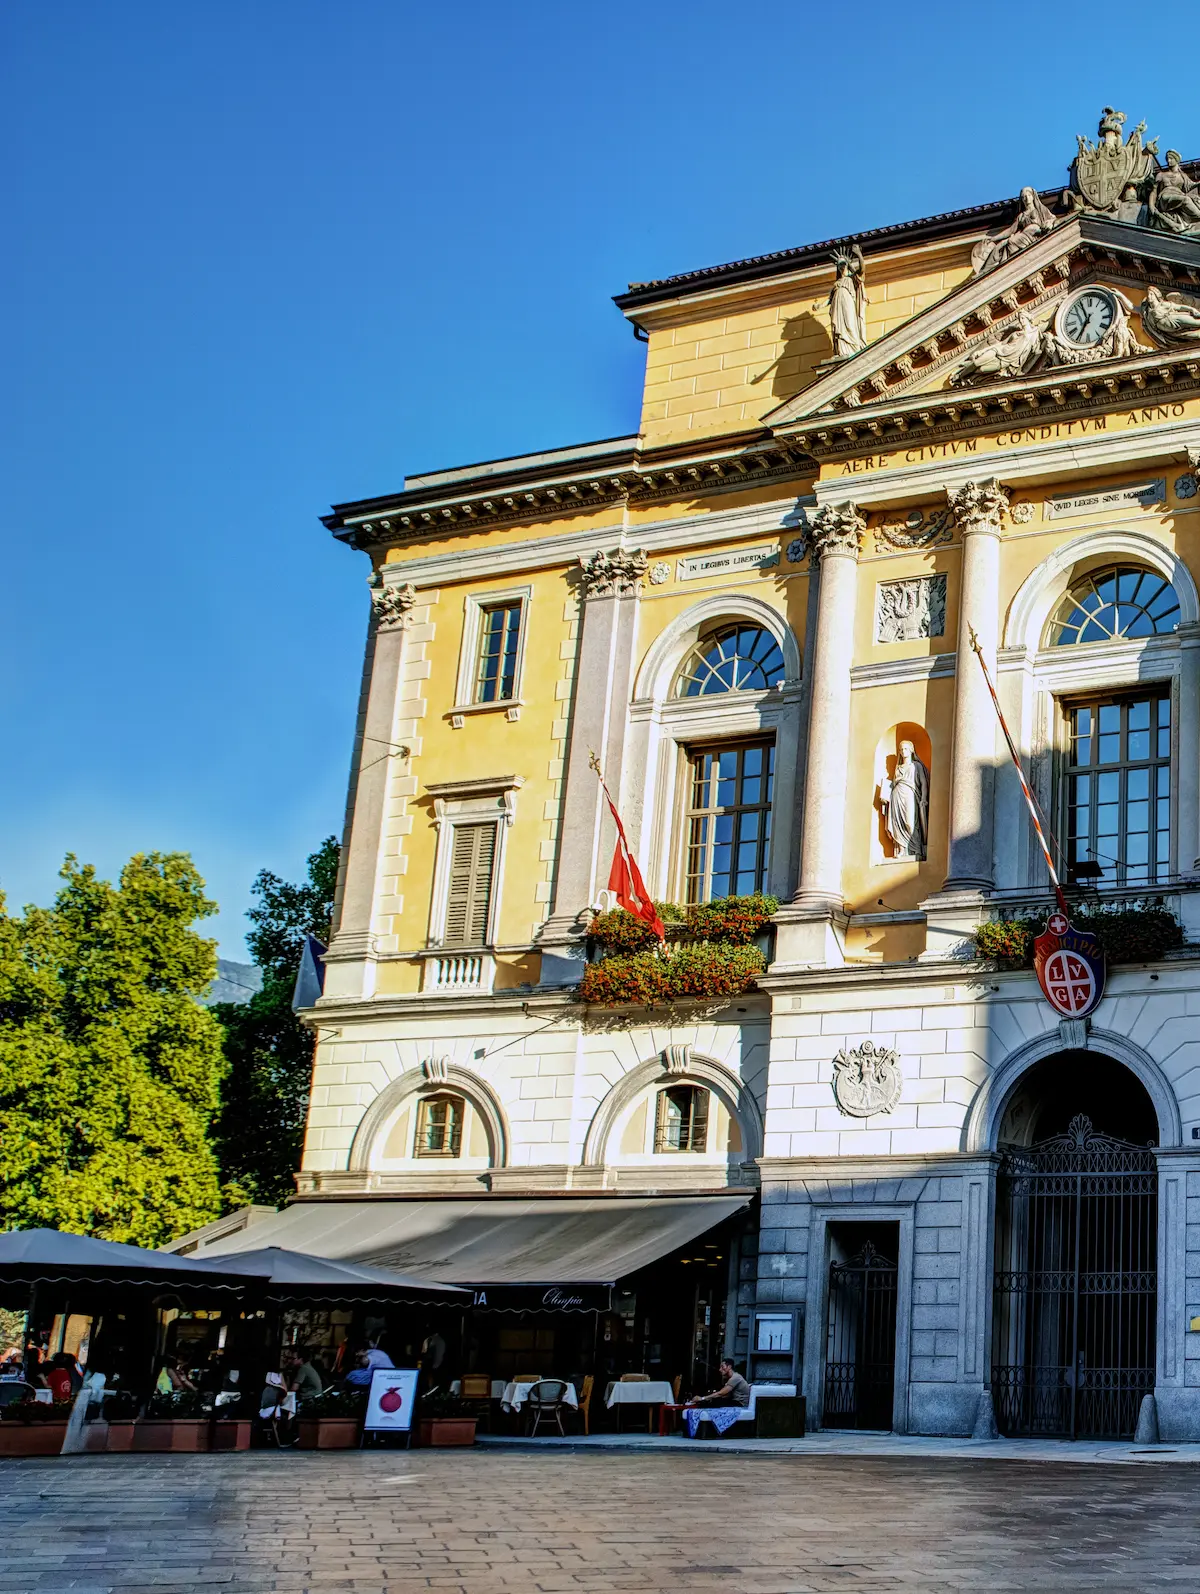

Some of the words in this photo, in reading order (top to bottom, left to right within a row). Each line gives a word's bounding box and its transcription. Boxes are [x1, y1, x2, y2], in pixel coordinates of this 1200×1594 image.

[840, 454, 889, 475] AERE
[905, 437, 978, 463] CIVIVM
[996, 415, 1107, 446] CONDITVM
[1126, 402, 1185, 425] ANNO
[1053, 501, 1072, 512] QVID
[1074, 497, 1099, 508] LEGES
[1102, 492, 1120, 502] SINE
[689, 564, 698, 572] IN
[700, 559, 730, 570] LEGIBVS
[733, 553, 767, 565] LIBERTAS
[541, 1286, 583, 1310] Olimpia
